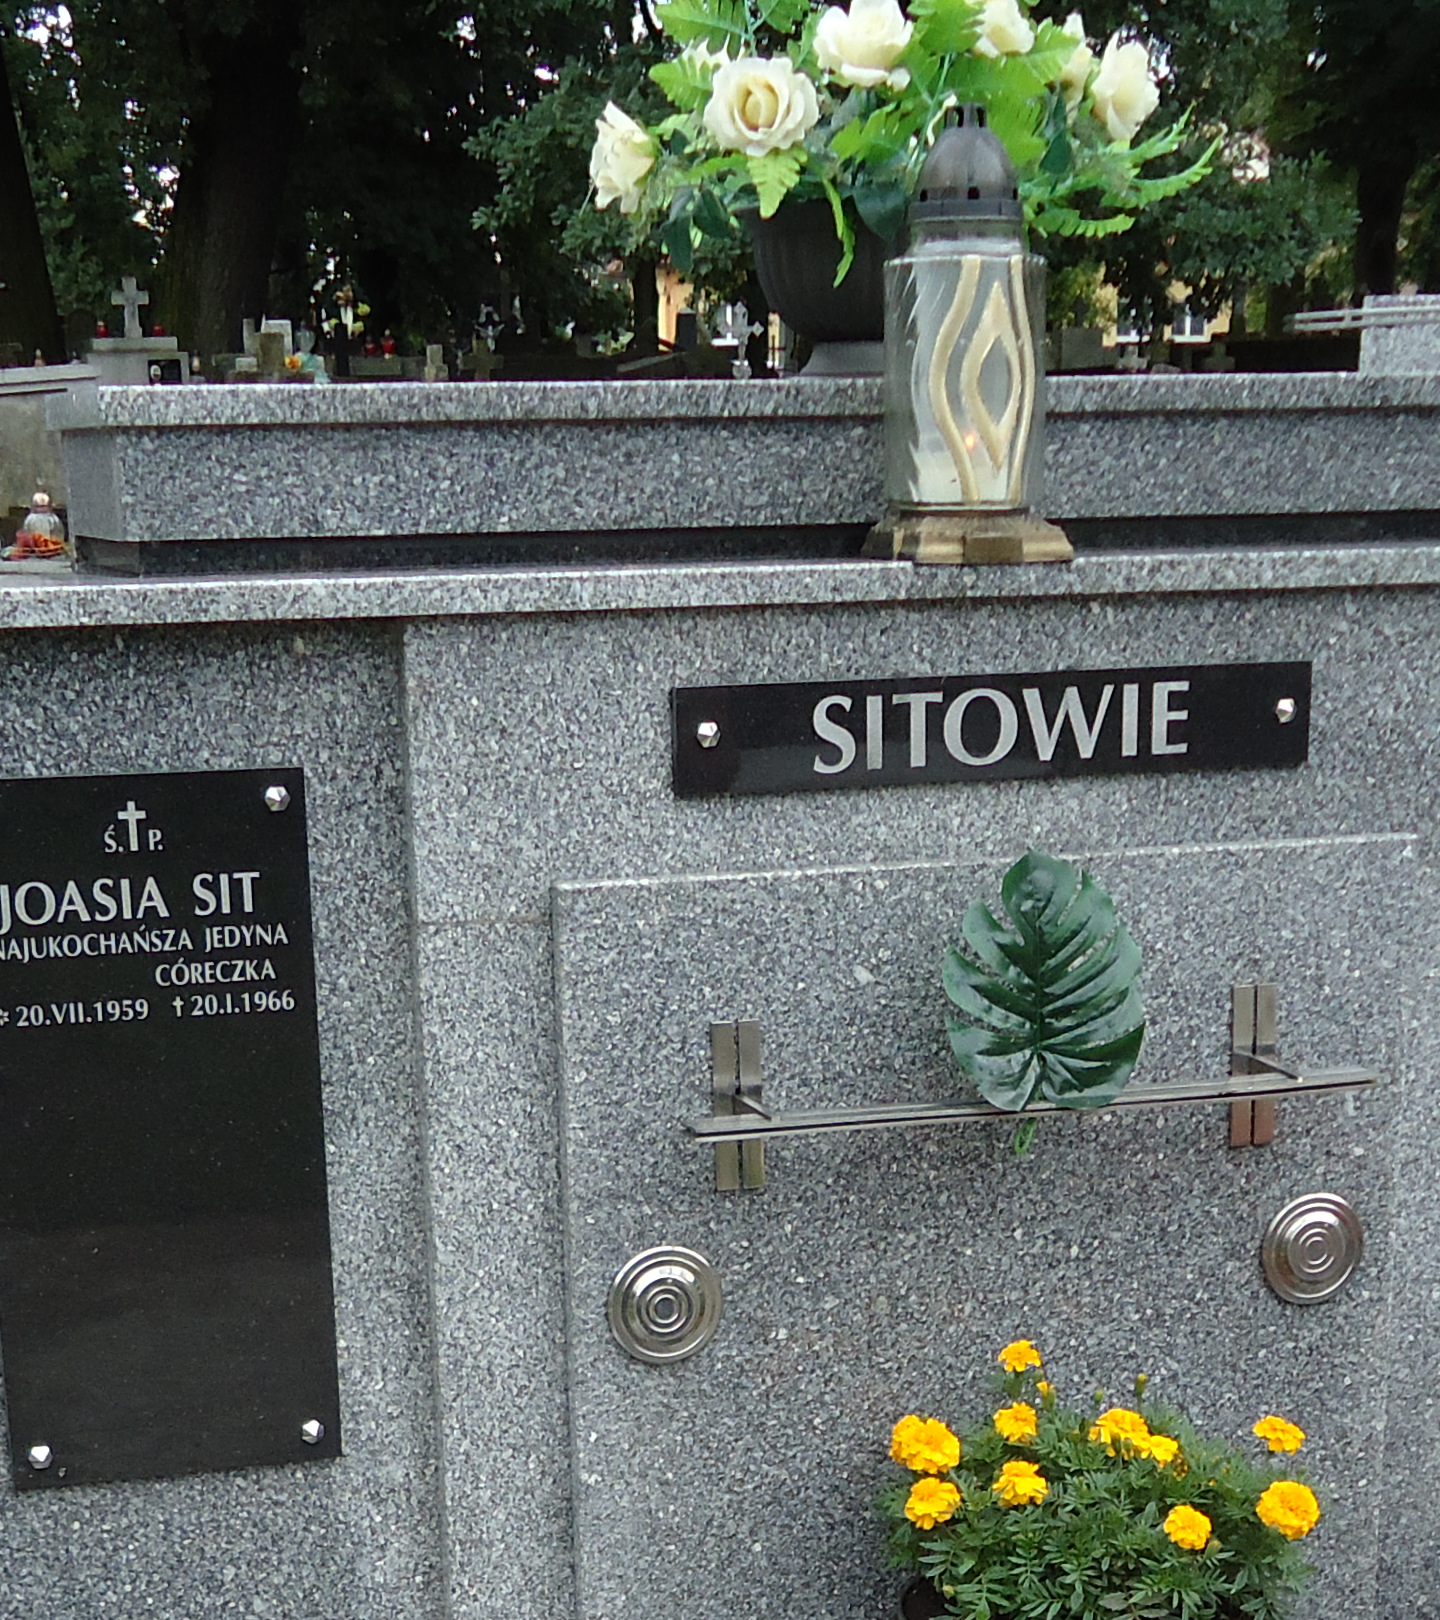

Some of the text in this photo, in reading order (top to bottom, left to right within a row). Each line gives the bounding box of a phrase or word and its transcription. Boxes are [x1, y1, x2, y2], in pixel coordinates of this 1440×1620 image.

[812, 681, 1190, 774] SITOWIE
[104, 824, 164, 853] Ś. P.
[0, 871, 260, 935] JOASIA SIT
[205, 922, 289, 953] JEDYNA
[155, 957, 277, 987] CÓRECZKA
[15, 989, 295, 1027] 20.VII.1959 20.I.1966
